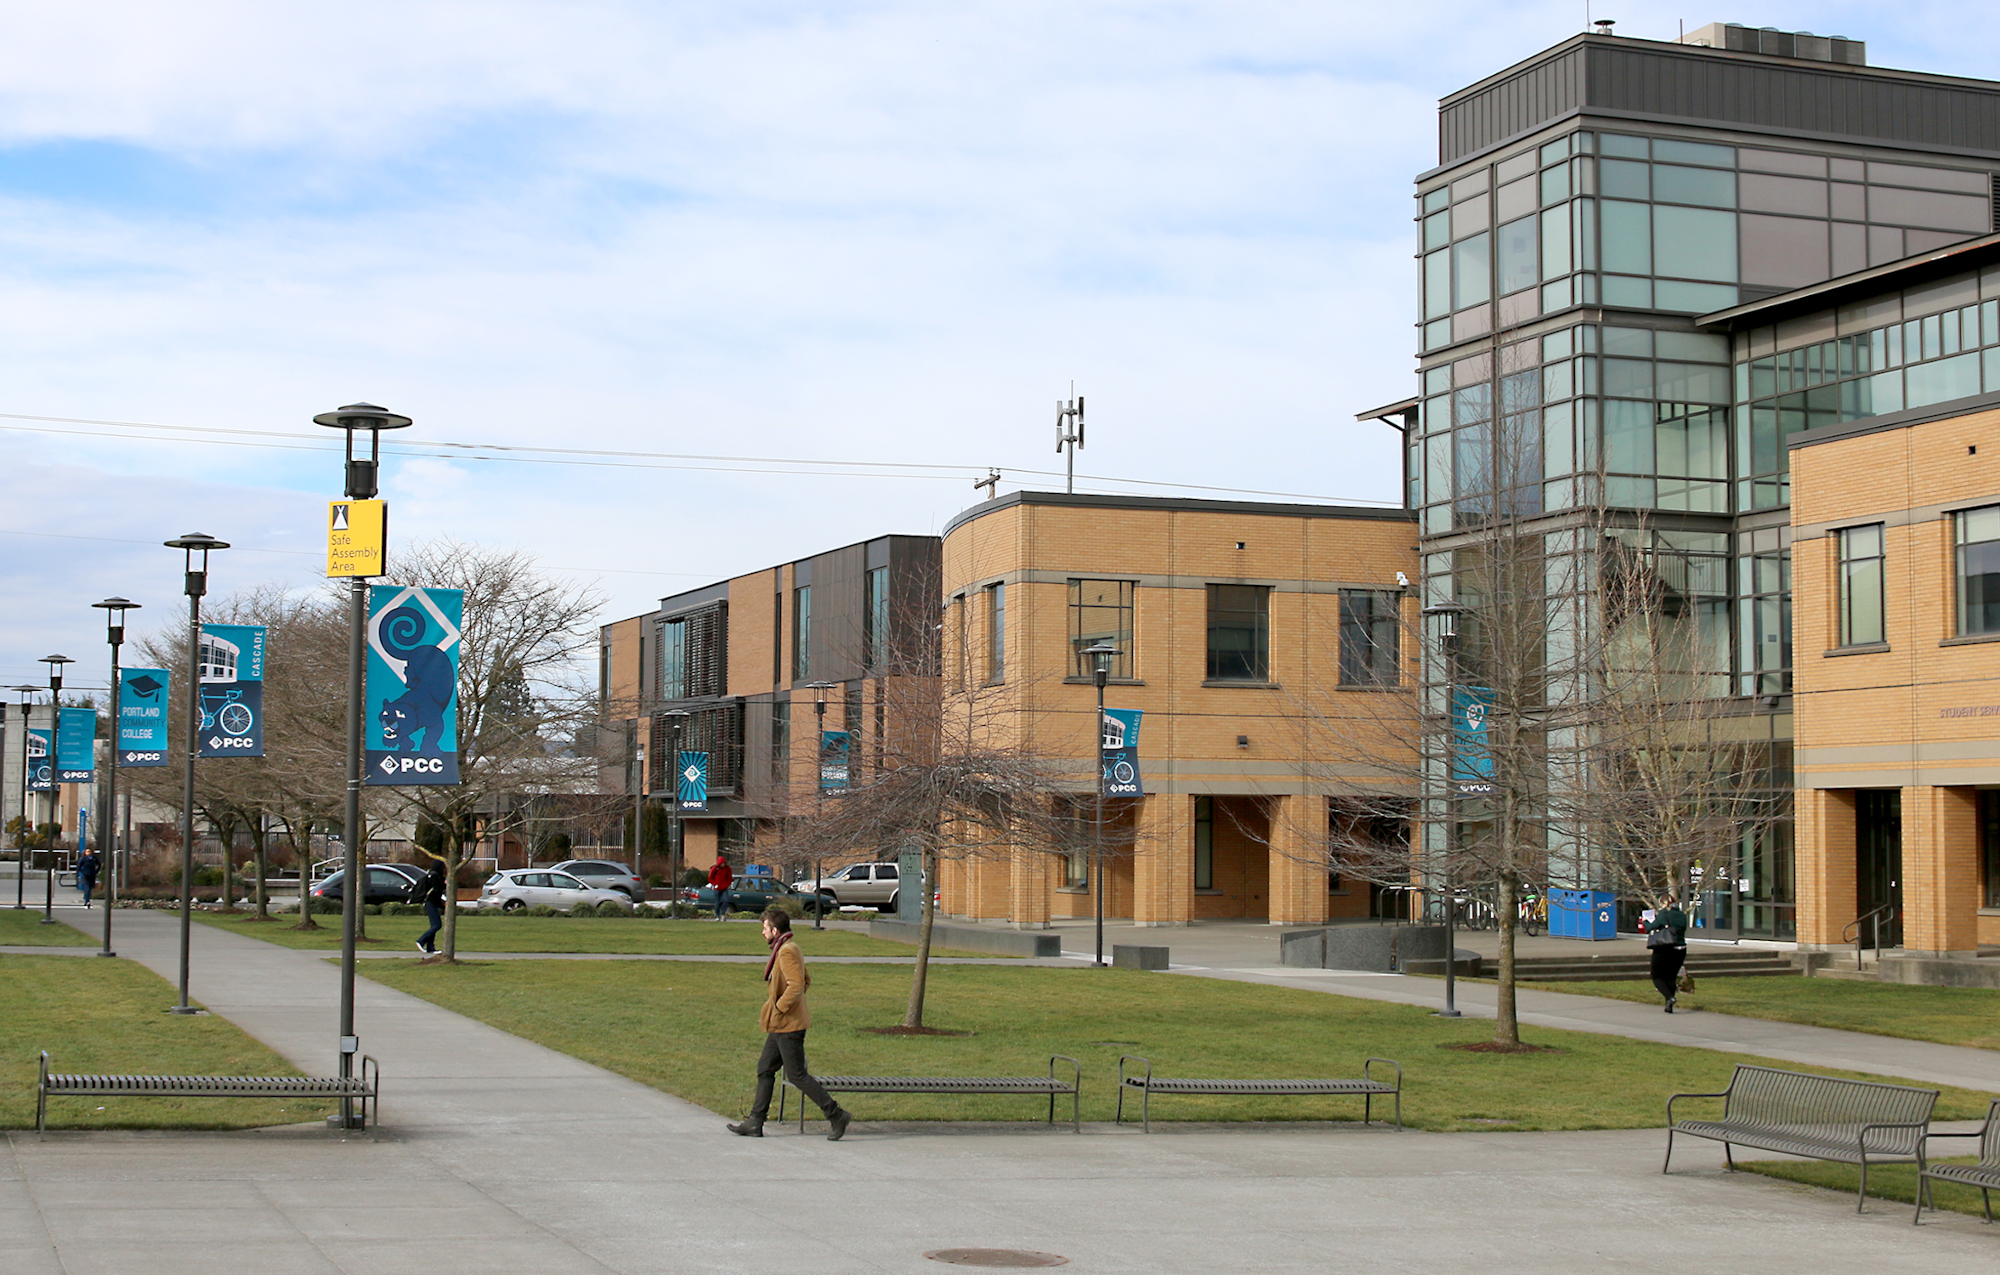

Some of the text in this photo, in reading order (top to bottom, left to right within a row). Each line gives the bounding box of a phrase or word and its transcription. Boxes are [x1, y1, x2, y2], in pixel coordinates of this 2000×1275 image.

[331, 534, 351, 546] Safe
[331, 547, 379, 560] Assembly
[331, 561, 355, 572] Area
[252, 631, 263, 676] CASCADE
[122, 707, 160, 717] PORTLAND
[1940, 706, 1978, 718] STUDENT
[122, 718, 166, 727] COMMUNITY
[122, 729, 153, 739] COLLEGE
[1131, 714, 1140, 744] CASCADE
[223, 737, 253, 748] PCC
[137, 752, 161, 761] PCC
[400, 757, 444, 773] PCC
[70, 771, 89, 779] PCC
[1118, 784, 1137, 792] PCC
